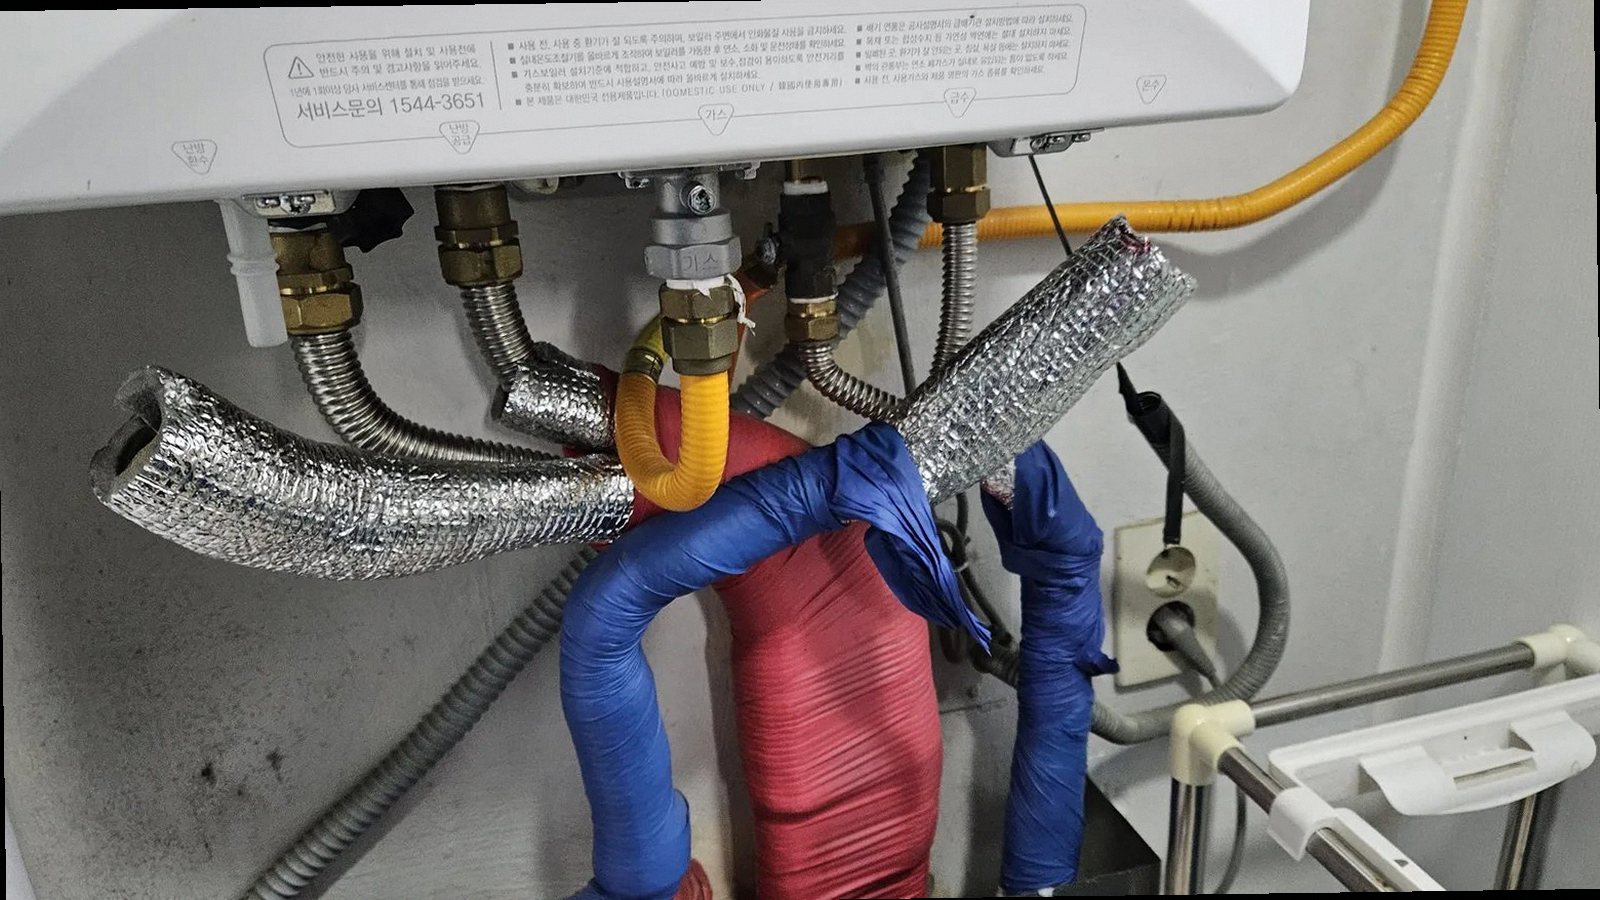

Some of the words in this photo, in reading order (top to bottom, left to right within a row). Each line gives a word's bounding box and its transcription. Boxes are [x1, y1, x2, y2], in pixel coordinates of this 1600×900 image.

[316, 53, 345, 63] 안전한
[350, 50, 376, 62] 사용을
[382, 48, 400, 59] 위해
[405, 47, 422, 58] 설치
[426, 47, 435, 57] 및
[440, 44, 476, 55] 사용전에
[320, 67, 348, 78] 반드시
[352, 65, 370, 76] 주의
[373, 64, 382, 74] 및
[387, 61, 430, 73] 경고사항을
[720, 85, 737, 94] USE
[742, 83, 765, 93] ONLY
[1142, 79, 1160, 92] 온수
[950, 91, 970, 104] 급수
[297, 97, 383, 120] 서비스문의
[390, 92, 484, 114] 1544-3651
[705, 109, 729, 121] 가스
[449, 123, 469, 134] 난방
[450, 134, 471, 146] 공급
[183, 143, 205, 154] 난방
[189, 155, 209, 168] 환수
[680, 253, 718, 273] 가스
